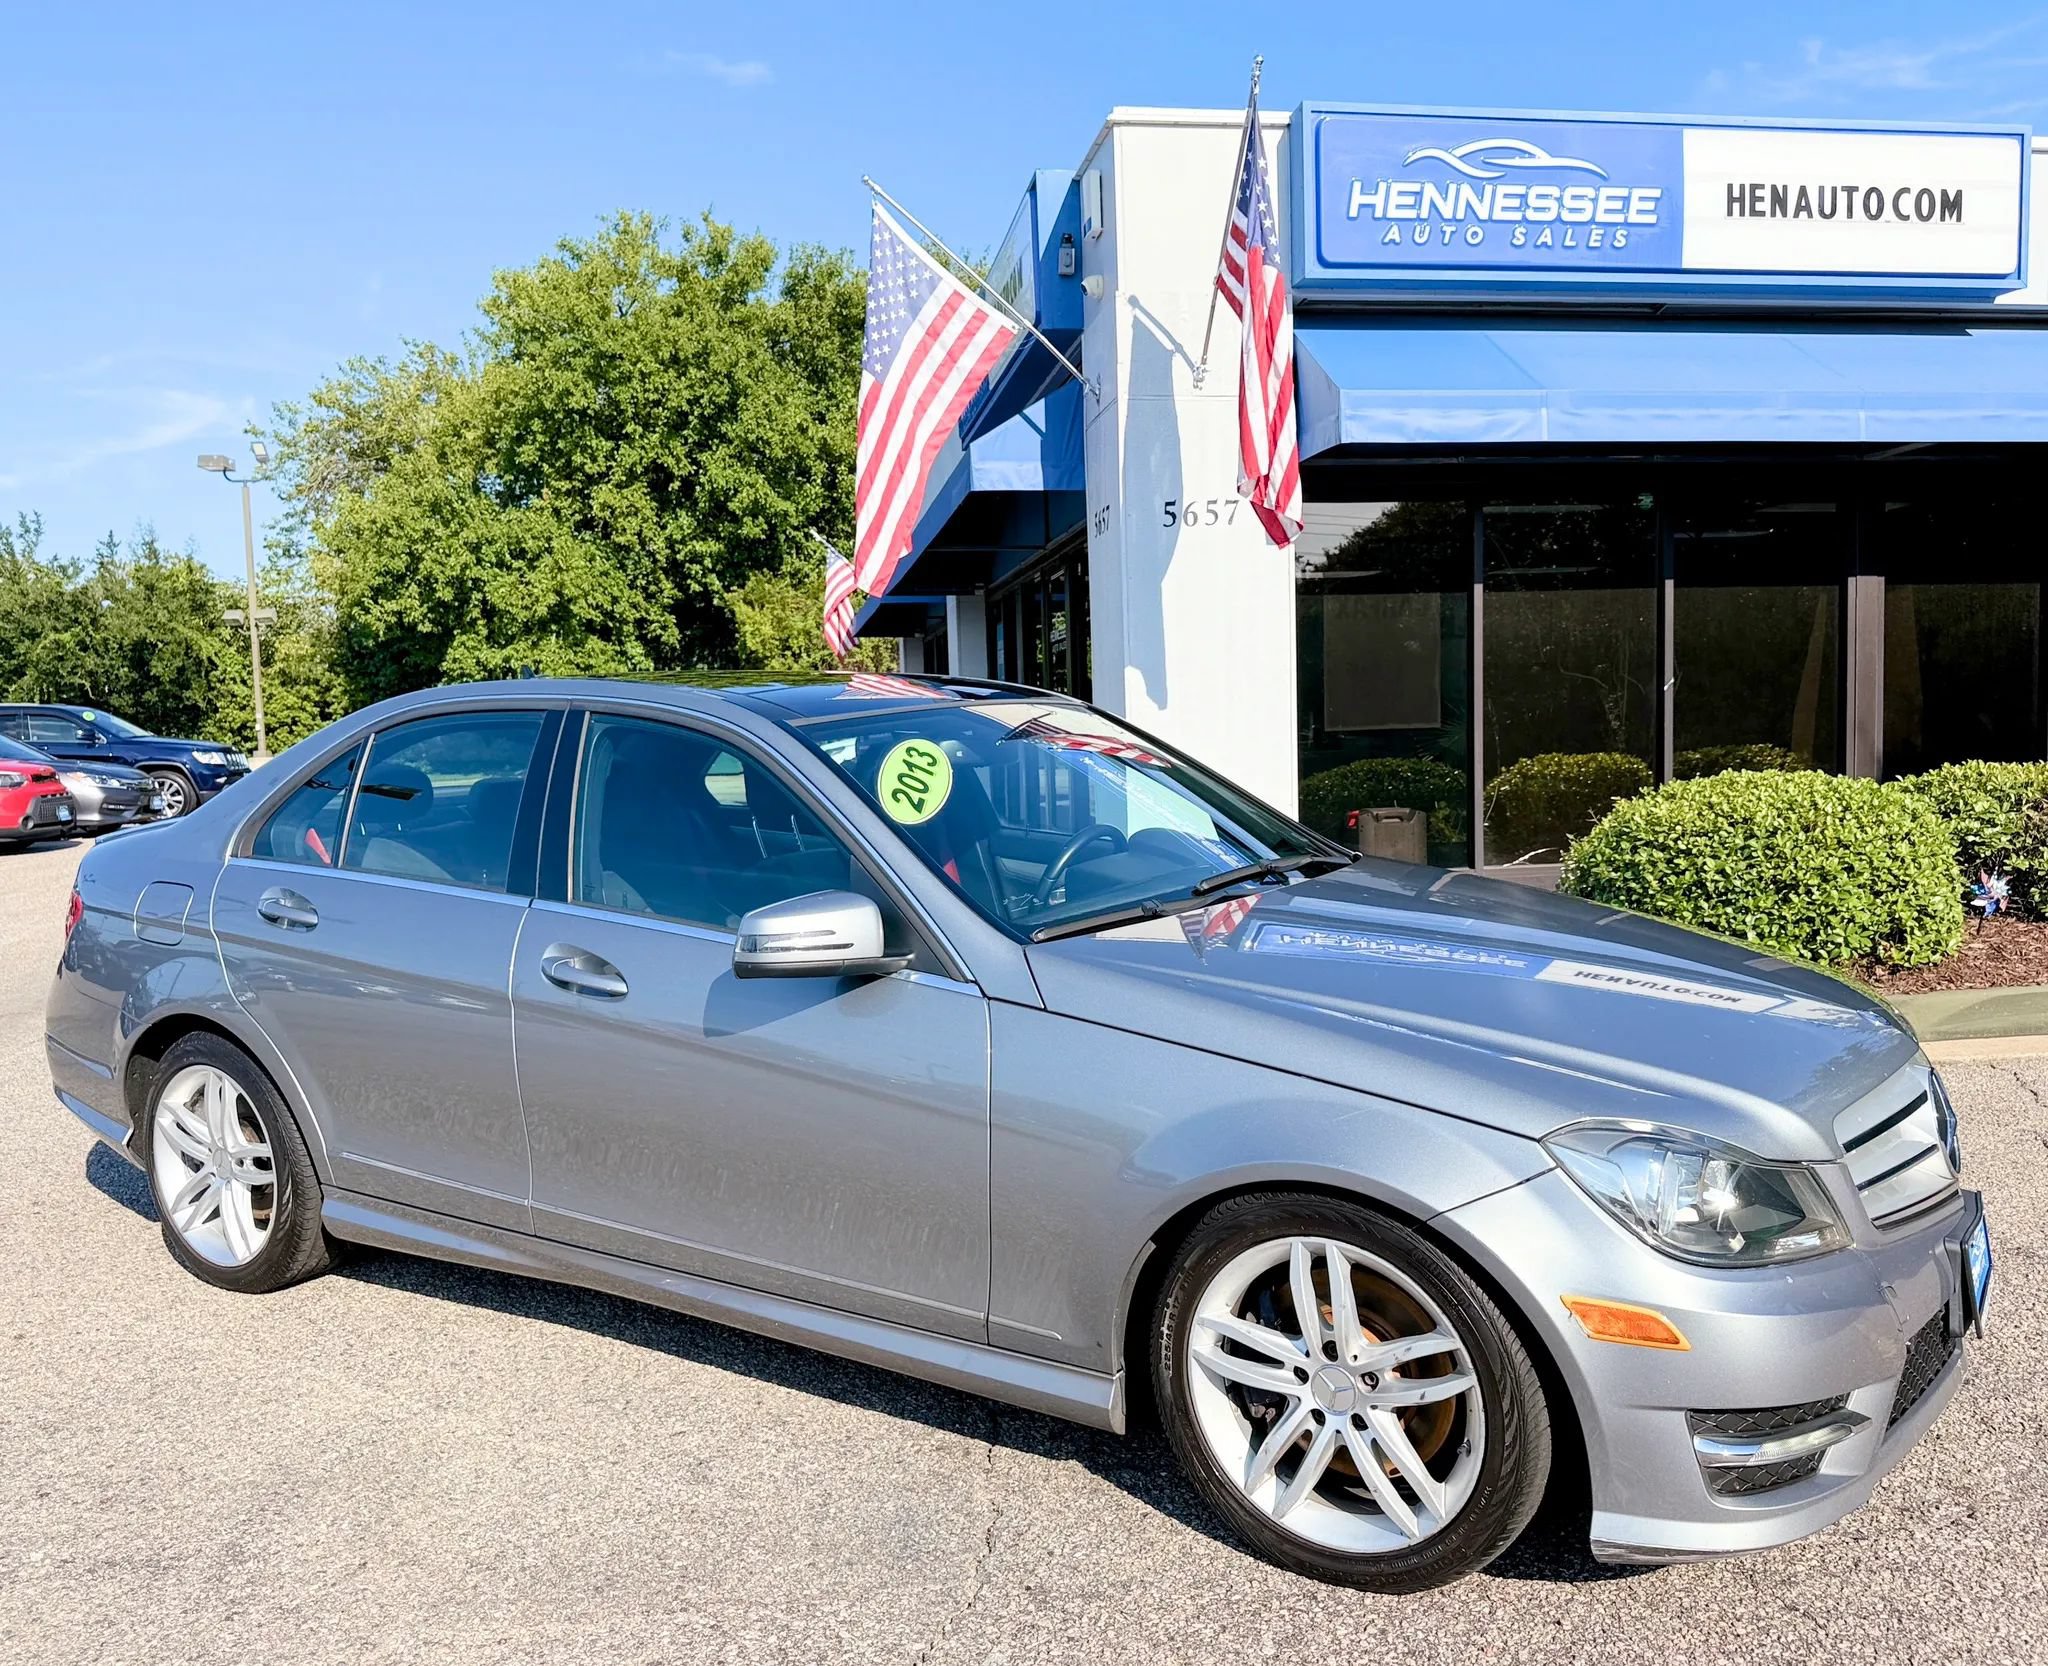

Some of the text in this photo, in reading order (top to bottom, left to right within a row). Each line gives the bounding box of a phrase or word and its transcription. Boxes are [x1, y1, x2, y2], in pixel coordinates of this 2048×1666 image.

[1347, 179, 1662, 224] HENNESSEE
[1381, 222, 1629, 248] AUTO SALES
[1095, 504, 1110, 538] 5657
[1162, 499, 1241, 527] 5657
[891, 746, 938, 814] 2013
